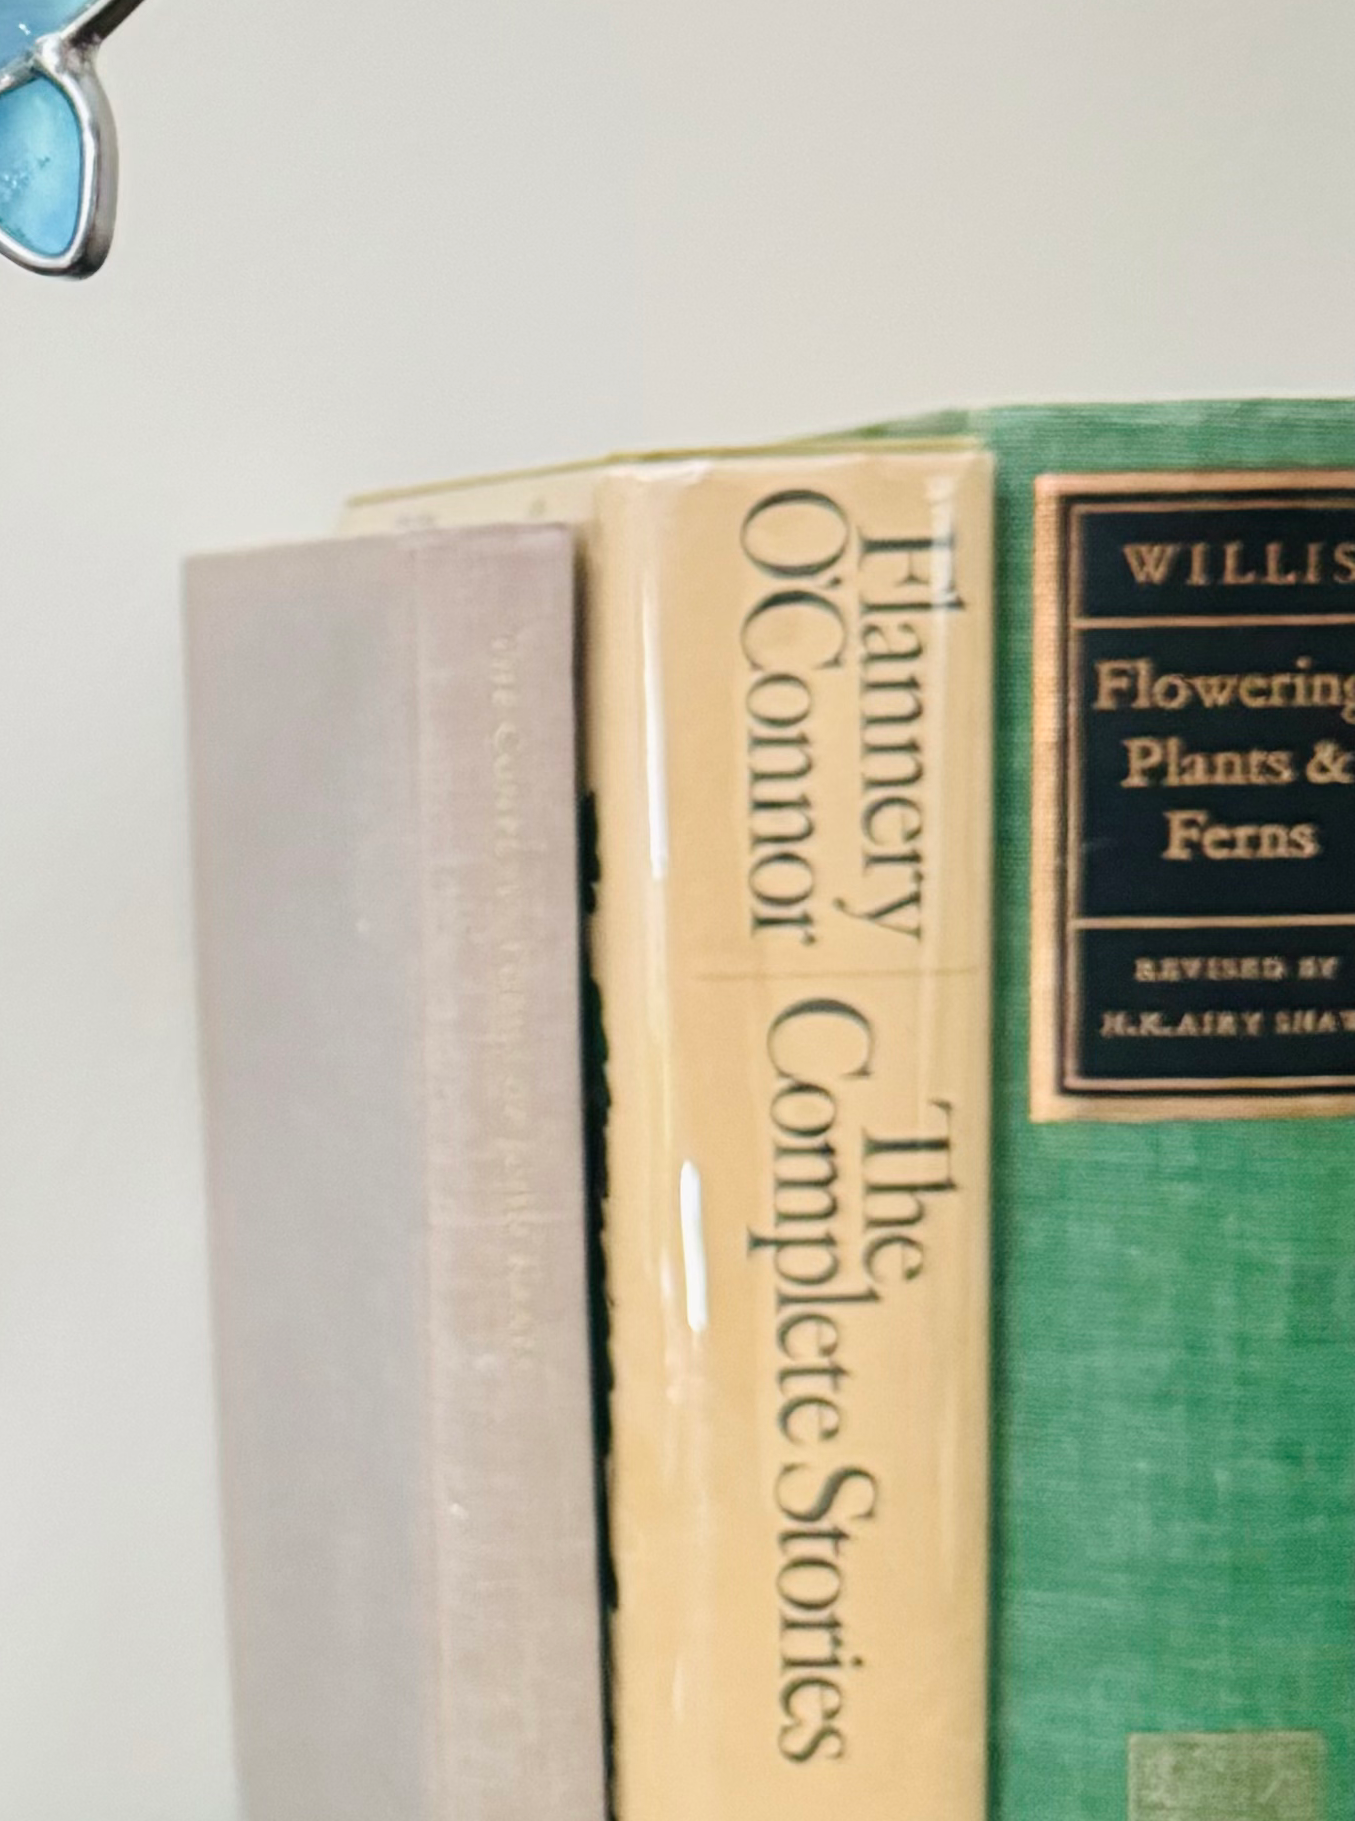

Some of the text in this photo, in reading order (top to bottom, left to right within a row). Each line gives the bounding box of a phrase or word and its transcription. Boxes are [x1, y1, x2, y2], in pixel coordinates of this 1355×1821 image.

[1122, 541, 1355, 586] WILLIS
[739, 488, 849, 946] O'Connor
[833, 526, 966, 941] Flannery
[1121, 735, 1355, 788] Plants &
[1161, 809, 1323, 861] Ferns
[1134, 955, 1340, 982] REVISED BY
[862, 1097, 959, 1285] The
[747, 996, 883, 1764] Complete Stories
